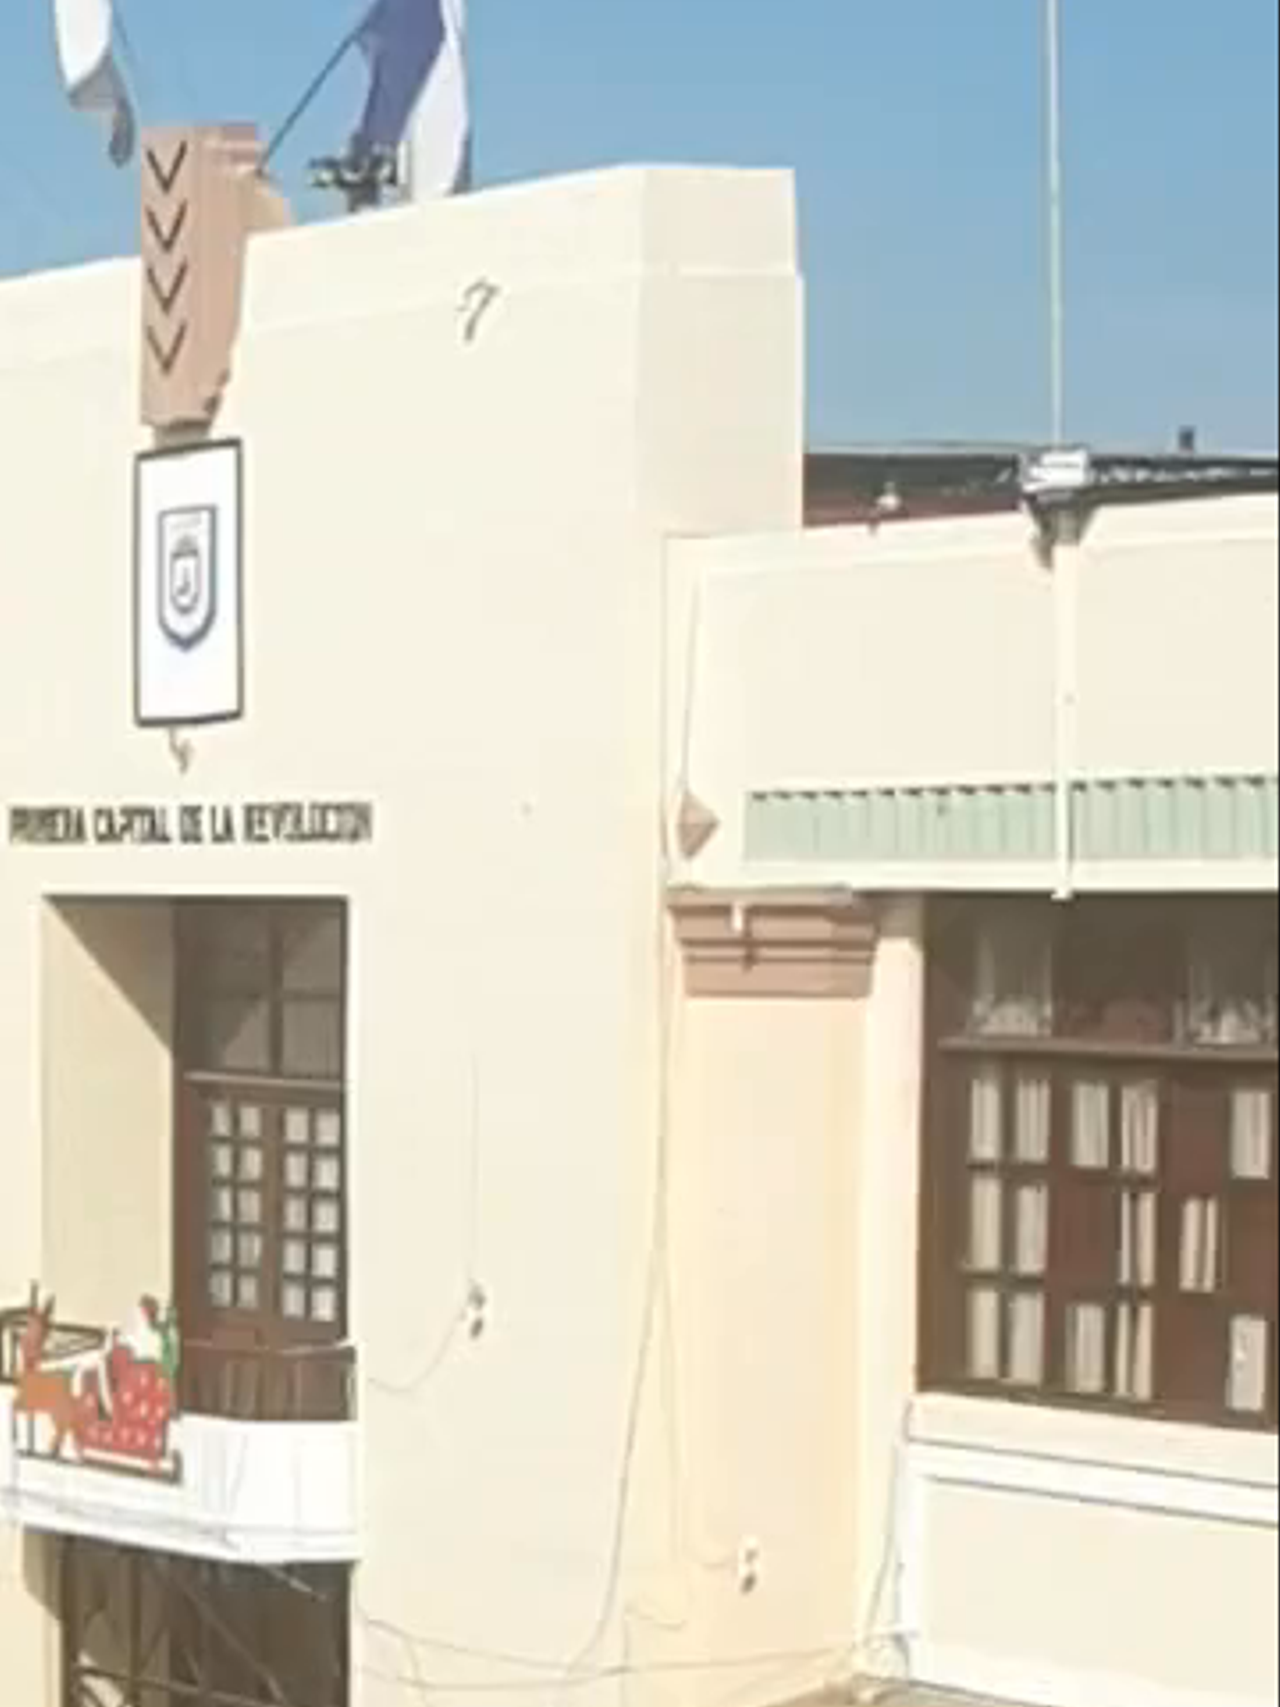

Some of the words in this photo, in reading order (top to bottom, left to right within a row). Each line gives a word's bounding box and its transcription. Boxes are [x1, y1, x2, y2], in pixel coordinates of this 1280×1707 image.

[94, 804, 172, 844] CAPITAL
[179, 803, 203, 843] DE
[210, 804, 235, 843] LA
